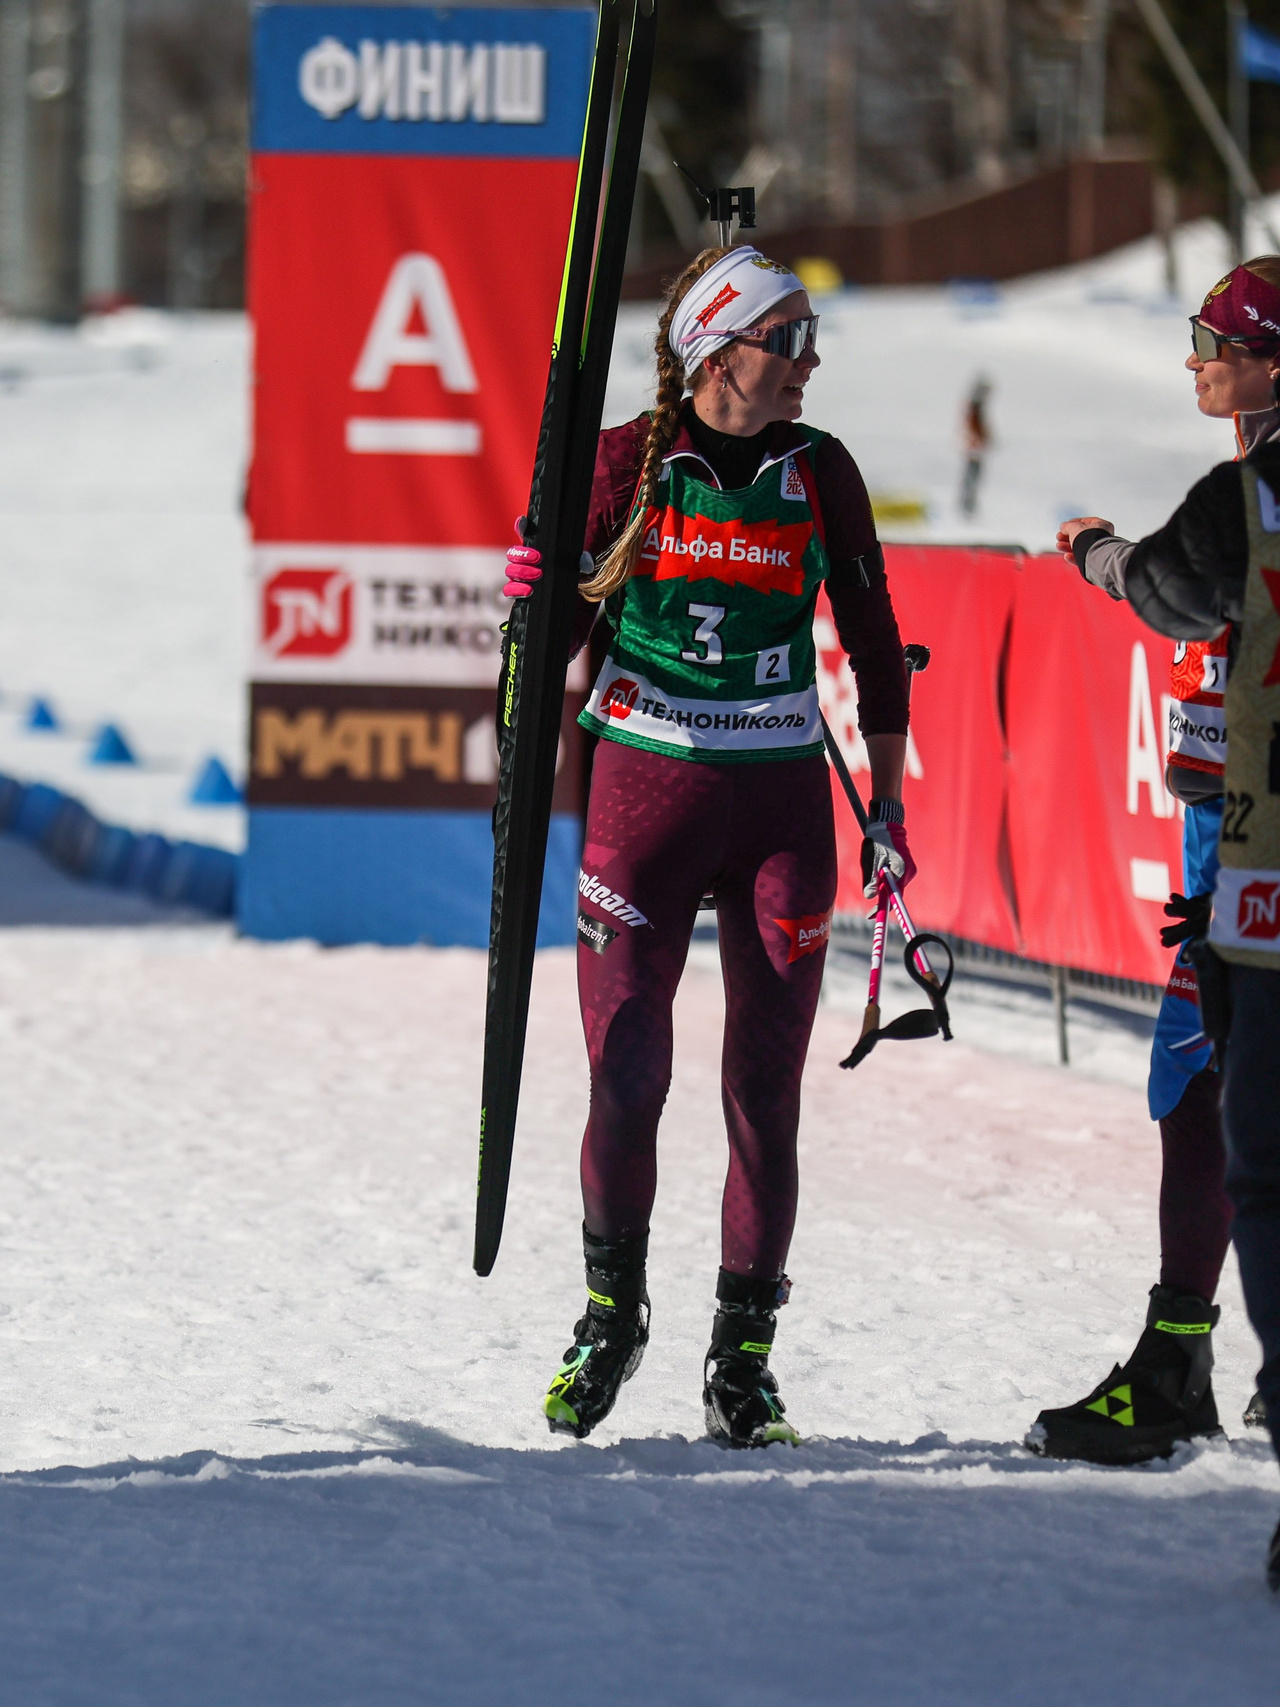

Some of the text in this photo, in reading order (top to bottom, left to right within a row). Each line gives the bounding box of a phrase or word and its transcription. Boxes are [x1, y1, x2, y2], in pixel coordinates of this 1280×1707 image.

[299, 36, 545, 123] ФИНИШ
[352, 251, 480, 394] А
[643, 527, 791, 567] Альфа Банк
[373, 622, 497, 655] НИКО
[682, 603, 725, 665] 3
[504, 642, 518, 727] FISCHER
[765, 653, 780, 679] 2
[258, 706, 461, 783] МАТЧ
[641, 698, 806, 731] ТЕХНОНИКОЛЬ
